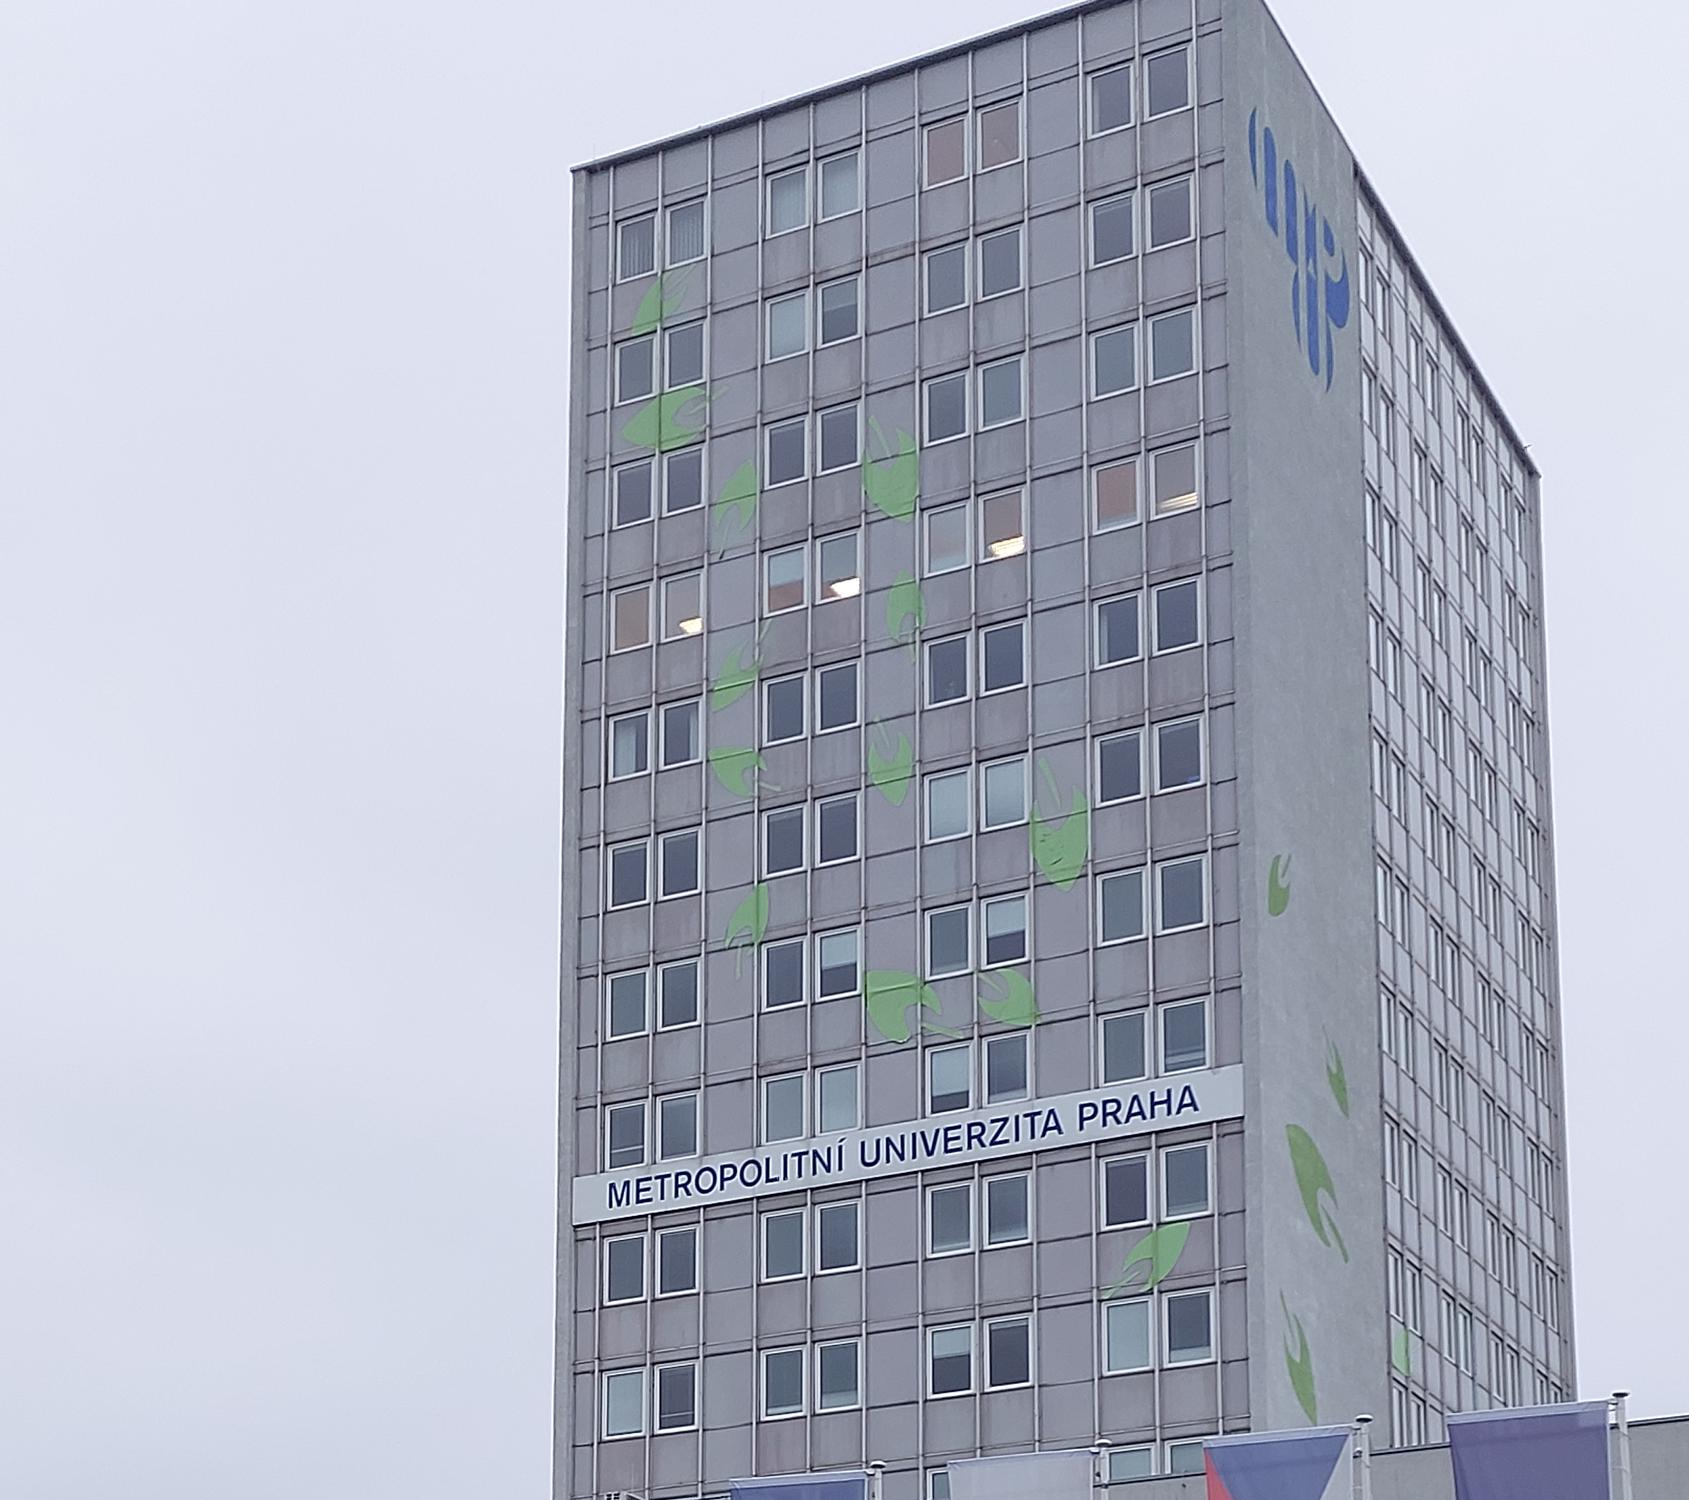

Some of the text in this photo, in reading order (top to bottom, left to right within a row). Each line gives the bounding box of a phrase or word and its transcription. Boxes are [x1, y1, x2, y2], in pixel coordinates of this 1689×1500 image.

[608, 1085, 1199, 1209] METROPOLITNÍ UNIVERZITA PRAHA
